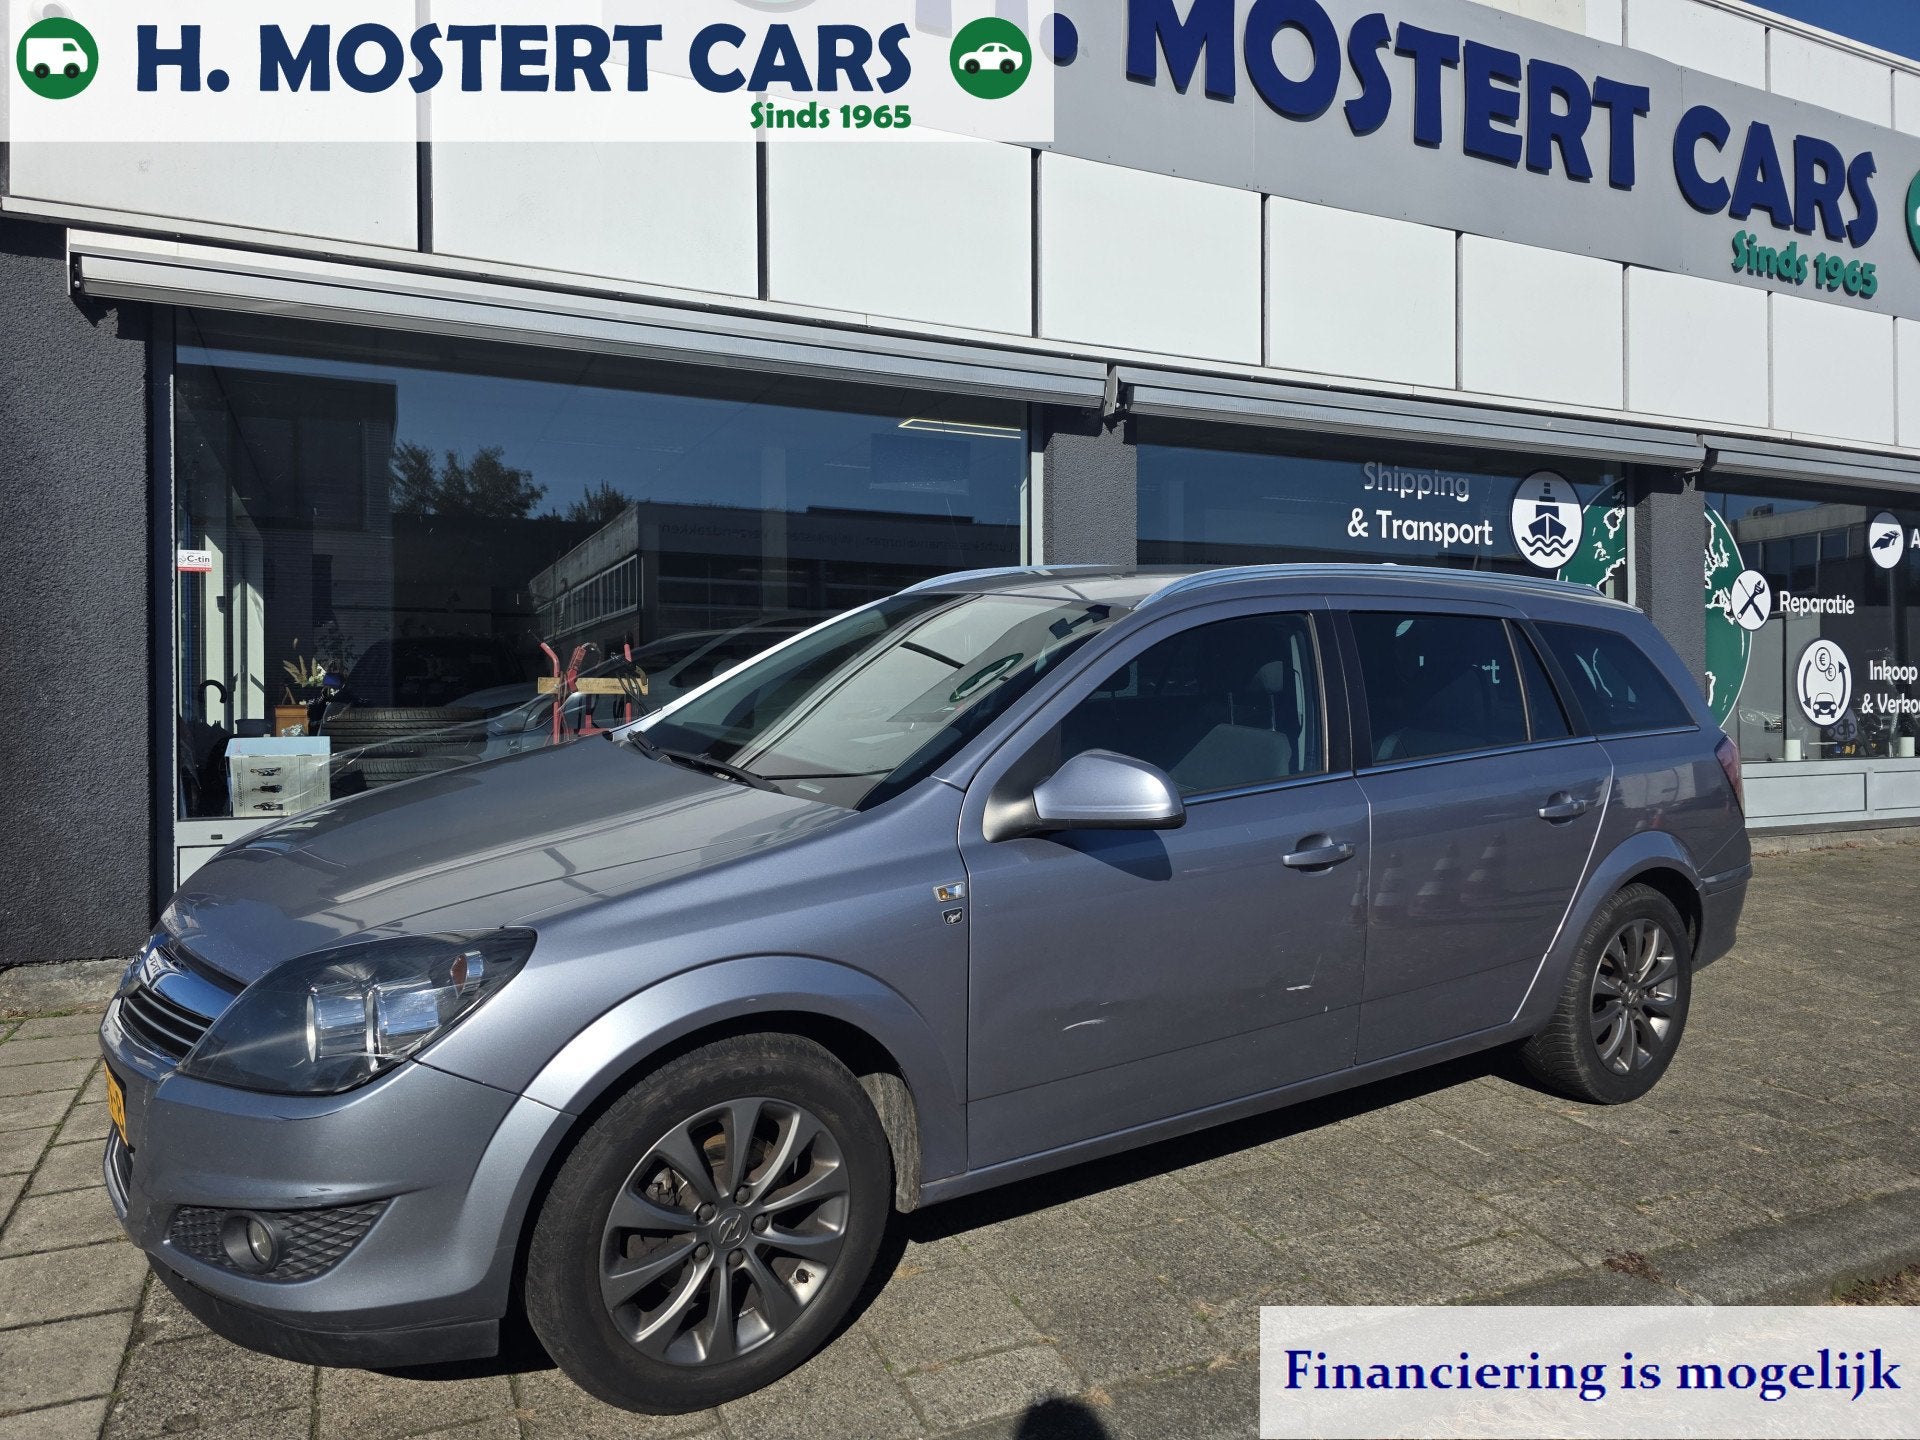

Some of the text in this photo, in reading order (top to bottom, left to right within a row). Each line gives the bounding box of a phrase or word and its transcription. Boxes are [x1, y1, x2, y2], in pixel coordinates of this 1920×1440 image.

[1126, 0, 1650, 190] MOSTERT
[1673, 105, 1878, 248] CARS
[1732, 230, 1878, 297] Sinds 1965
[1363, 461, 1470, 502] Shipping
[1347, 507, 1493, 549] & Transport
[1779, 590, 1855, 617] Reparatie
[1869, 659, 1918, 685] Inkoop
[1861, 693, 1874, 714] &
